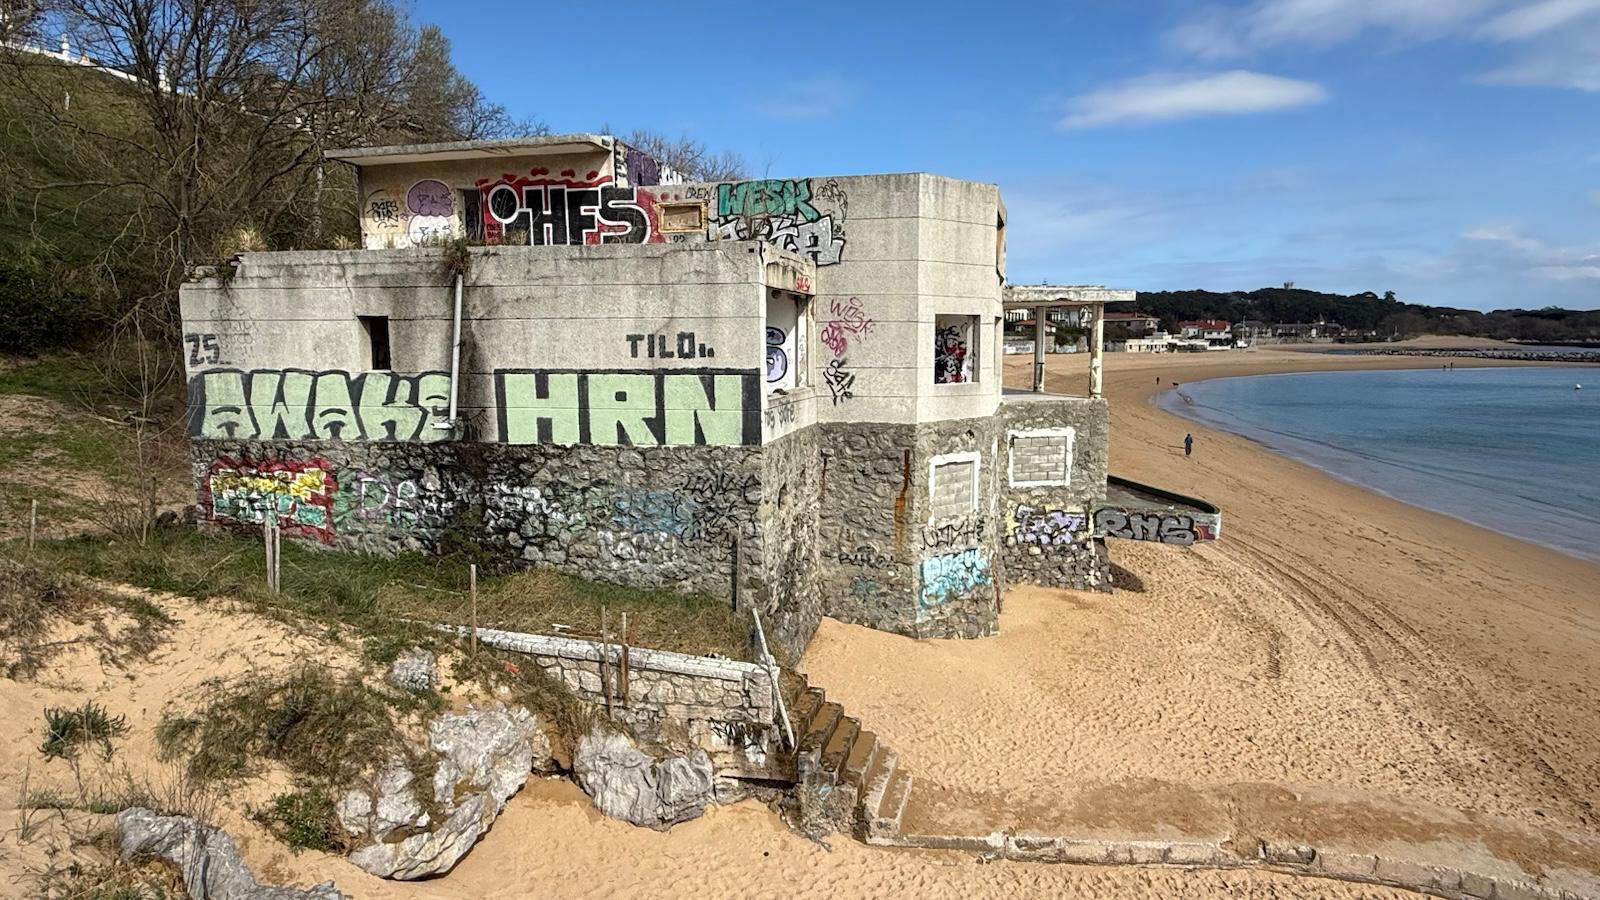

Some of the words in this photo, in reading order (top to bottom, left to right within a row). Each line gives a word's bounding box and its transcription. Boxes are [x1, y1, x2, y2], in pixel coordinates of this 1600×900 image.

[717, 178, 821, 221] WESK
[494, 367, 761, 448] HRN
[1093, 507, 1195, 546] RNS
